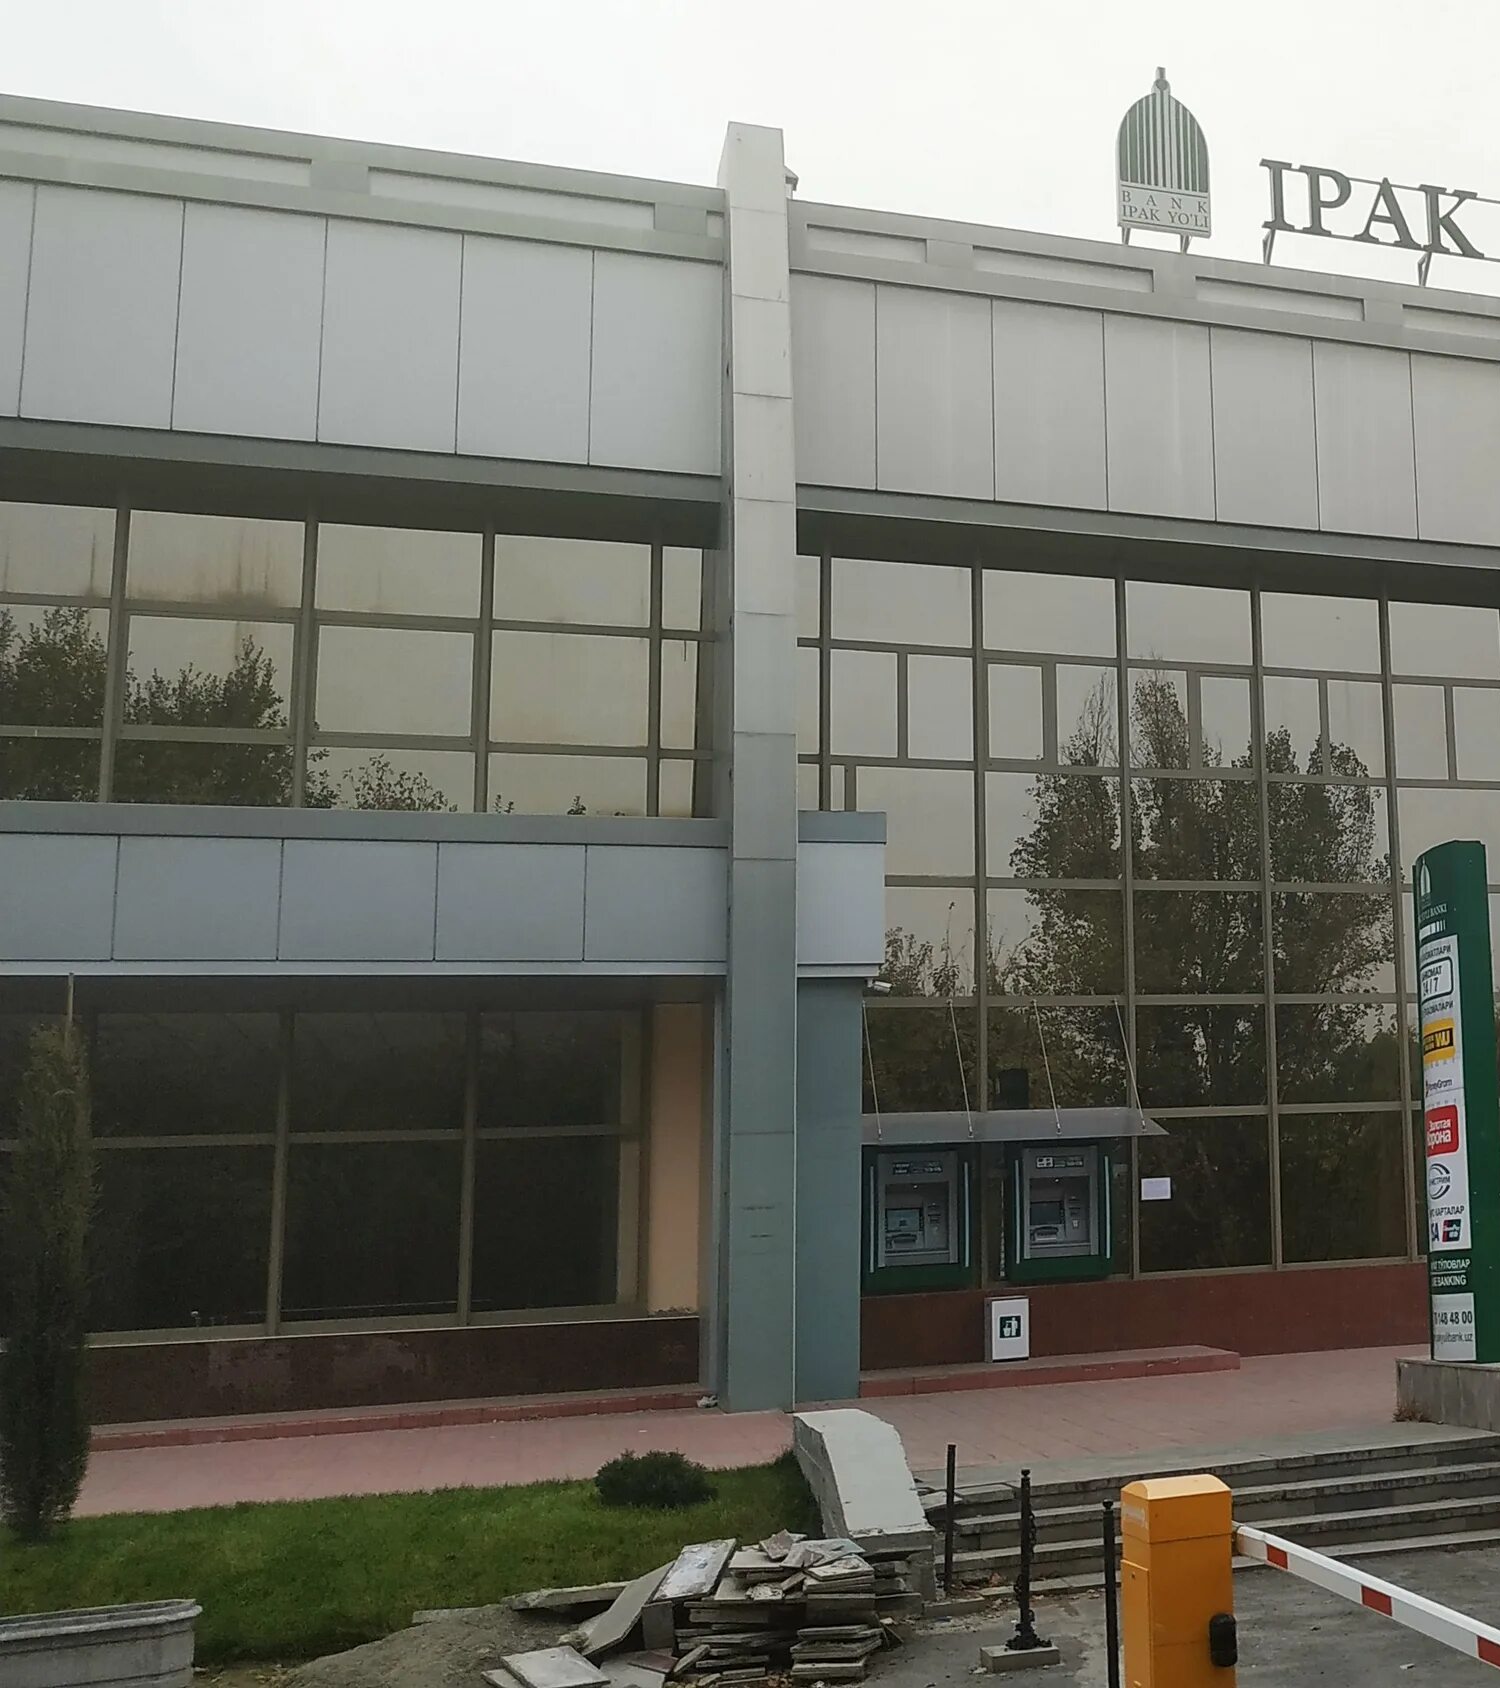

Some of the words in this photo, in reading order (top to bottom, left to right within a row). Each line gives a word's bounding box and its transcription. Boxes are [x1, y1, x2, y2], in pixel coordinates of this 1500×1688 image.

[1121, 190, 1208, 214] BANK
[1259, 158, 1485, 259] IPAK
[1121, 204, 1161, 222] IPAK
[1168, 211, 1209, 228] YO'LI
[1461, 1310, 1473, 1324] 00
